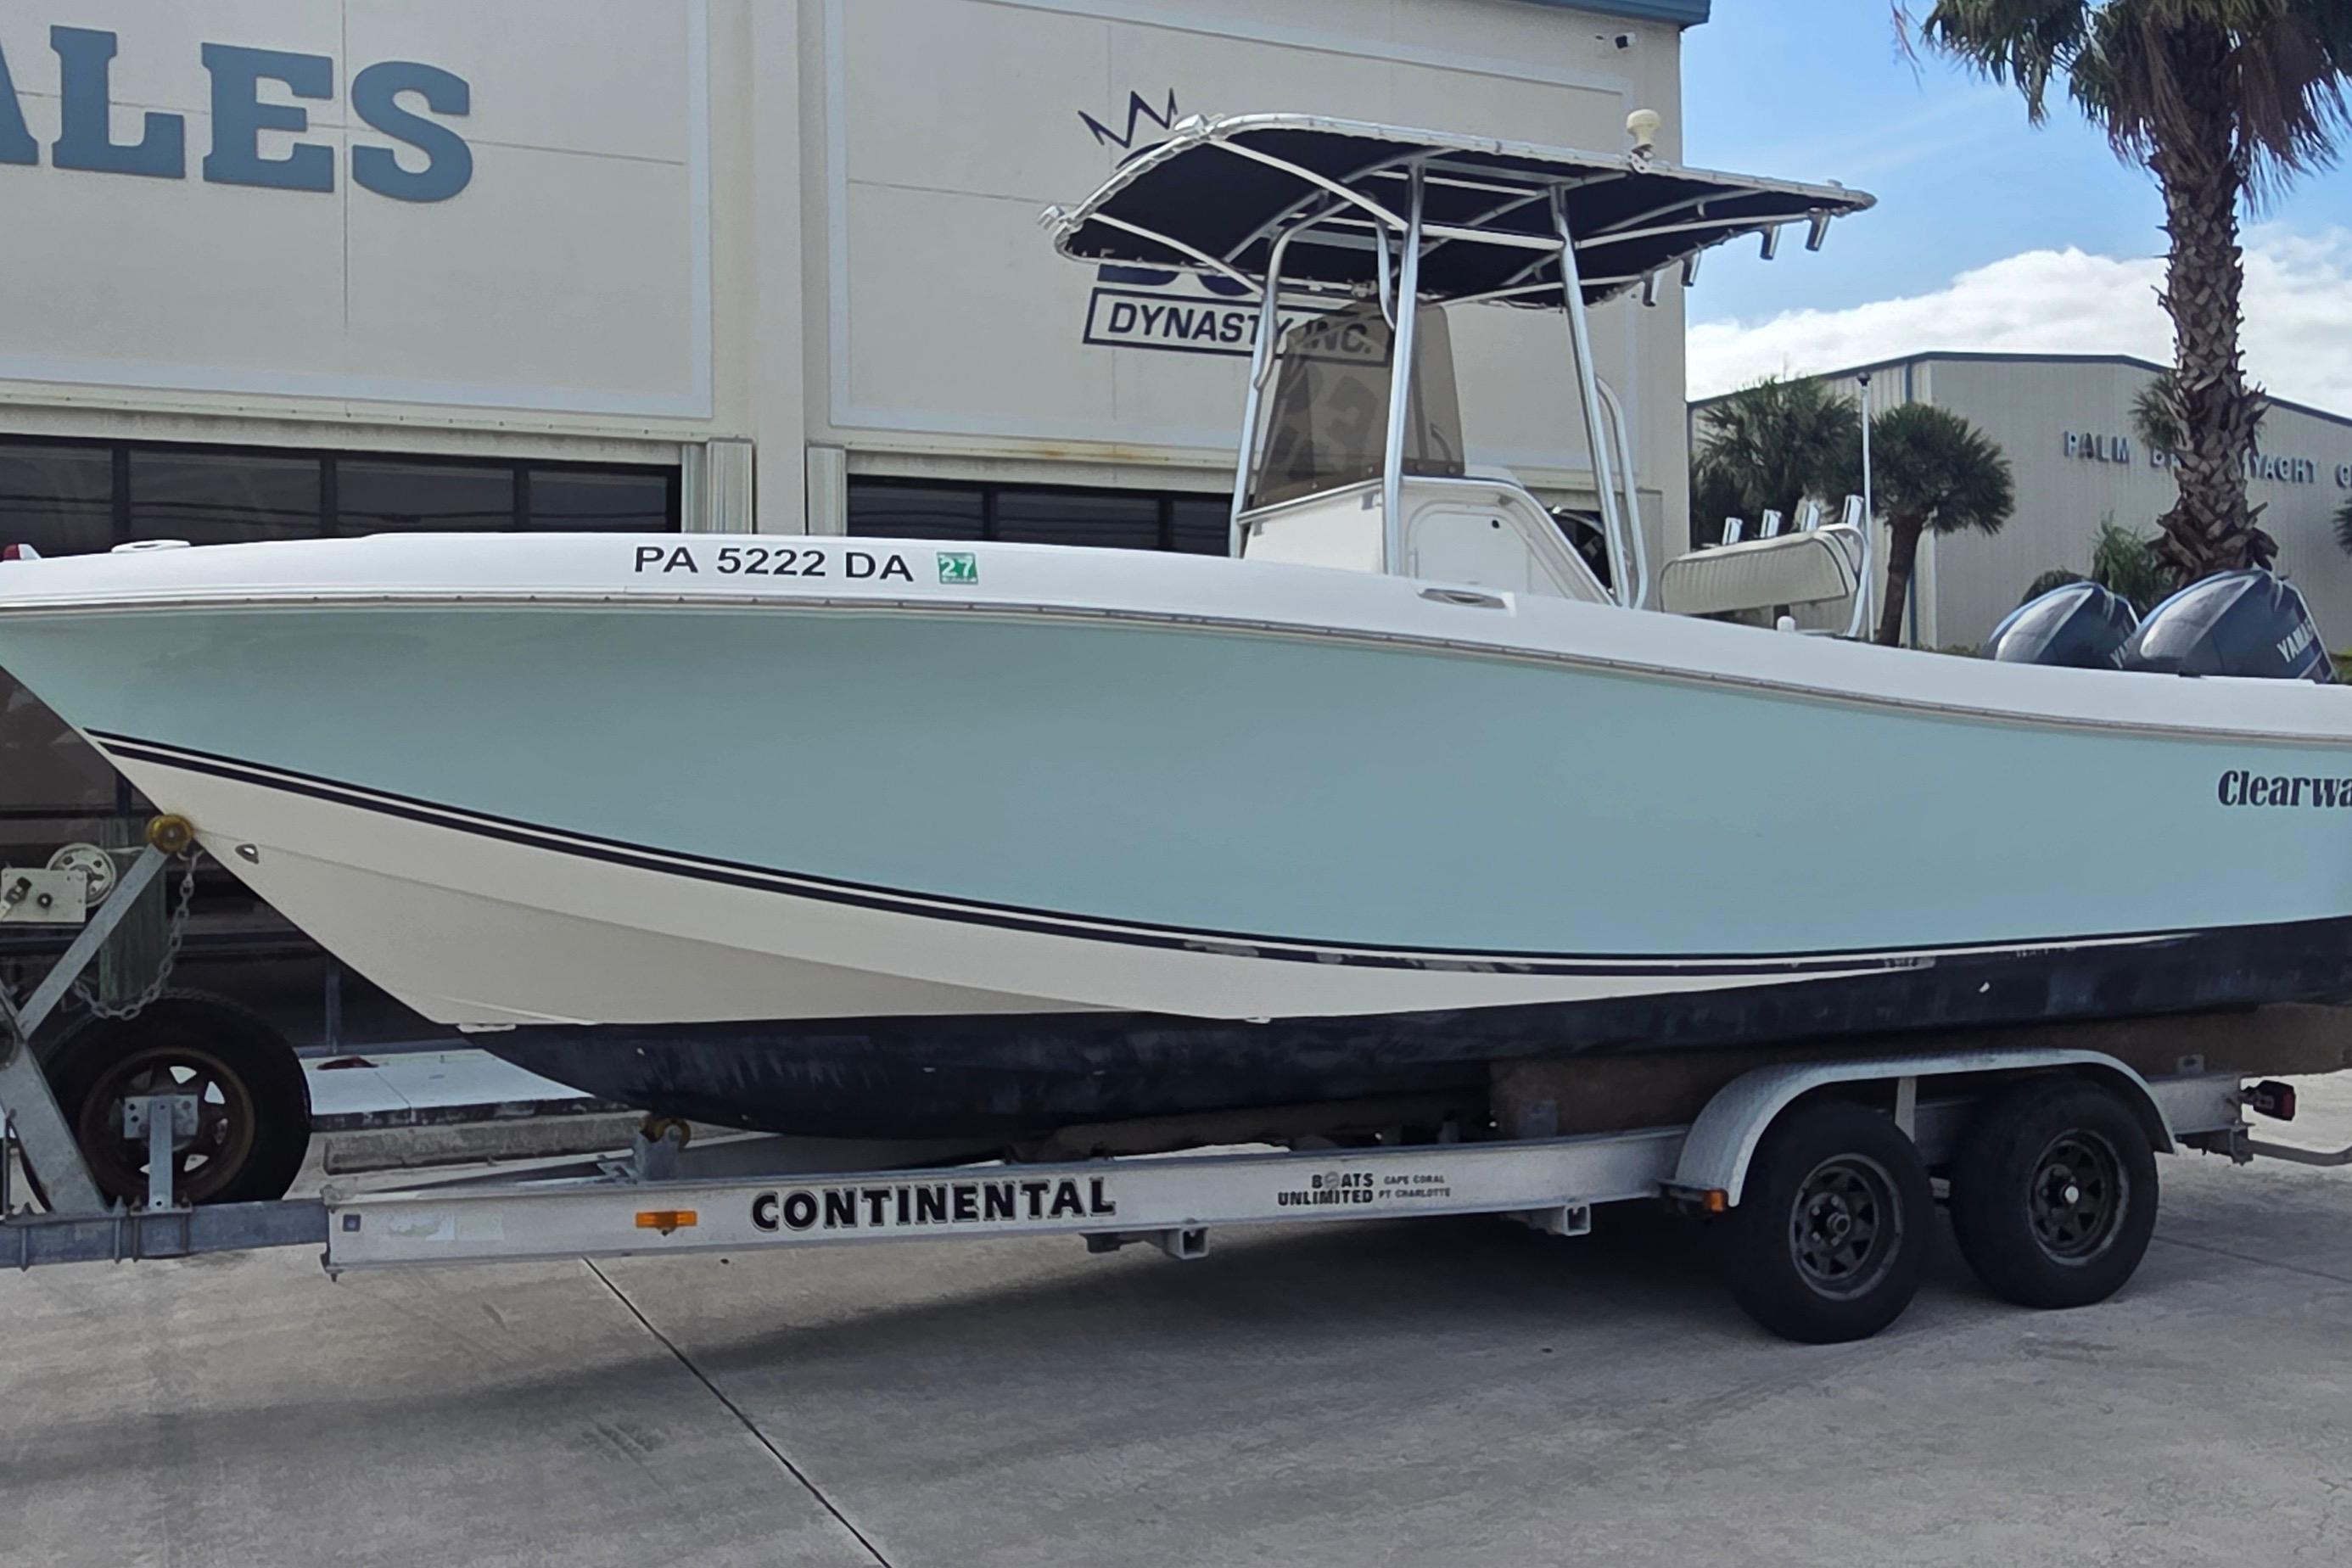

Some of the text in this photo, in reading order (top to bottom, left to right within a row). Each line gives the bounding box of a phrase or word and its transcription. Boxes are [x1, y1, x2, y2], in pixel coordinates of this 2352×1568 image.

[1303, 320, 1372, 354] INC.
[2064, 431, 2129, 464] PALM
[636, 546, 914, 582] PA 5222 DA
[940, 557, 973, 577] 27
[1278, 1188, 1450, 1206] UNLIMITED PT CHARLOTTE
[1312, 1173, 1444, 1188] BOATS CAPE CORAL
[752, 1177, 1117, 1232] CONTINENTAL
